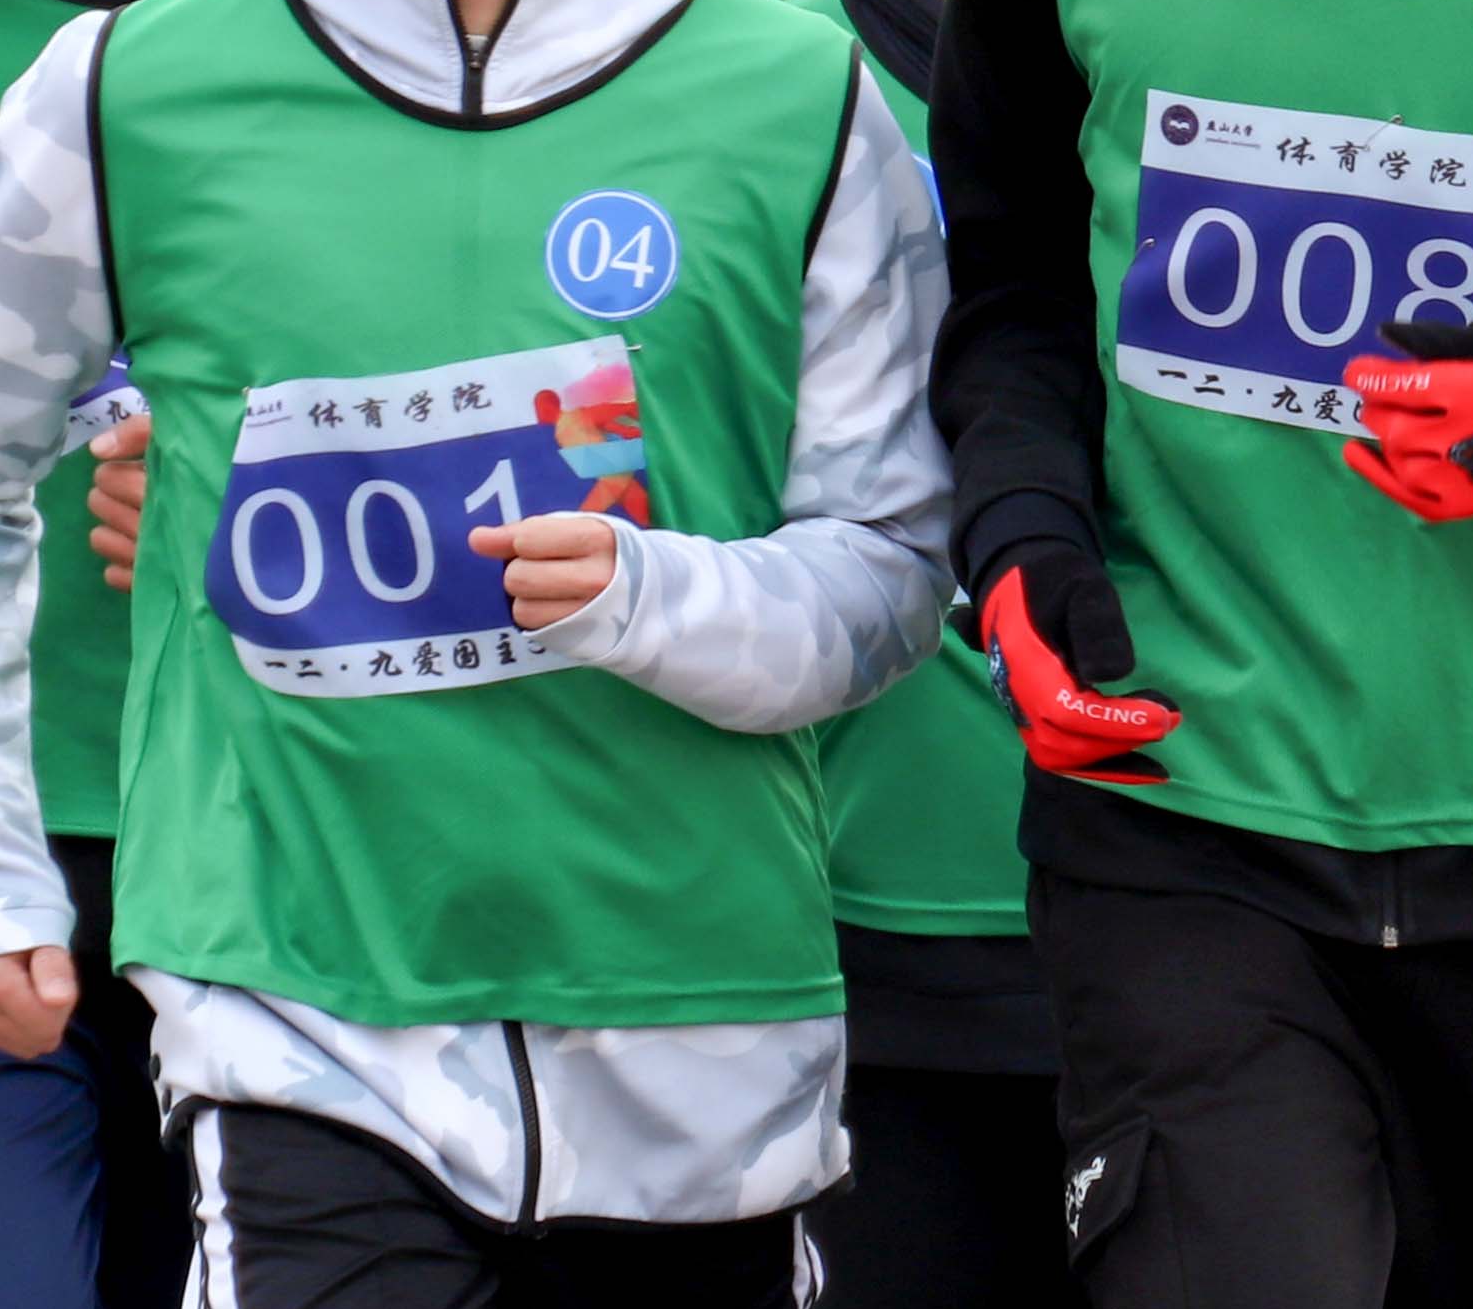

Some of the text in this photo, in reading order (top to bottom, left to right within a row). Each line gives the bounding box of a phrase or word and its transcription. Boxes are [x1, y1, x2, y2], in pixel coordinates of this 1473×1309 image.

[1276, 137, 1467, 188] 体育学院
[567, 217, 654, 289] 04
[308, 382, 493, 429] 体育学院
[1157, 368, 1363, 424] 一二·九爱
[231, 459, 523, 616] 001
[1056, 689, 1148, 725] RACING
